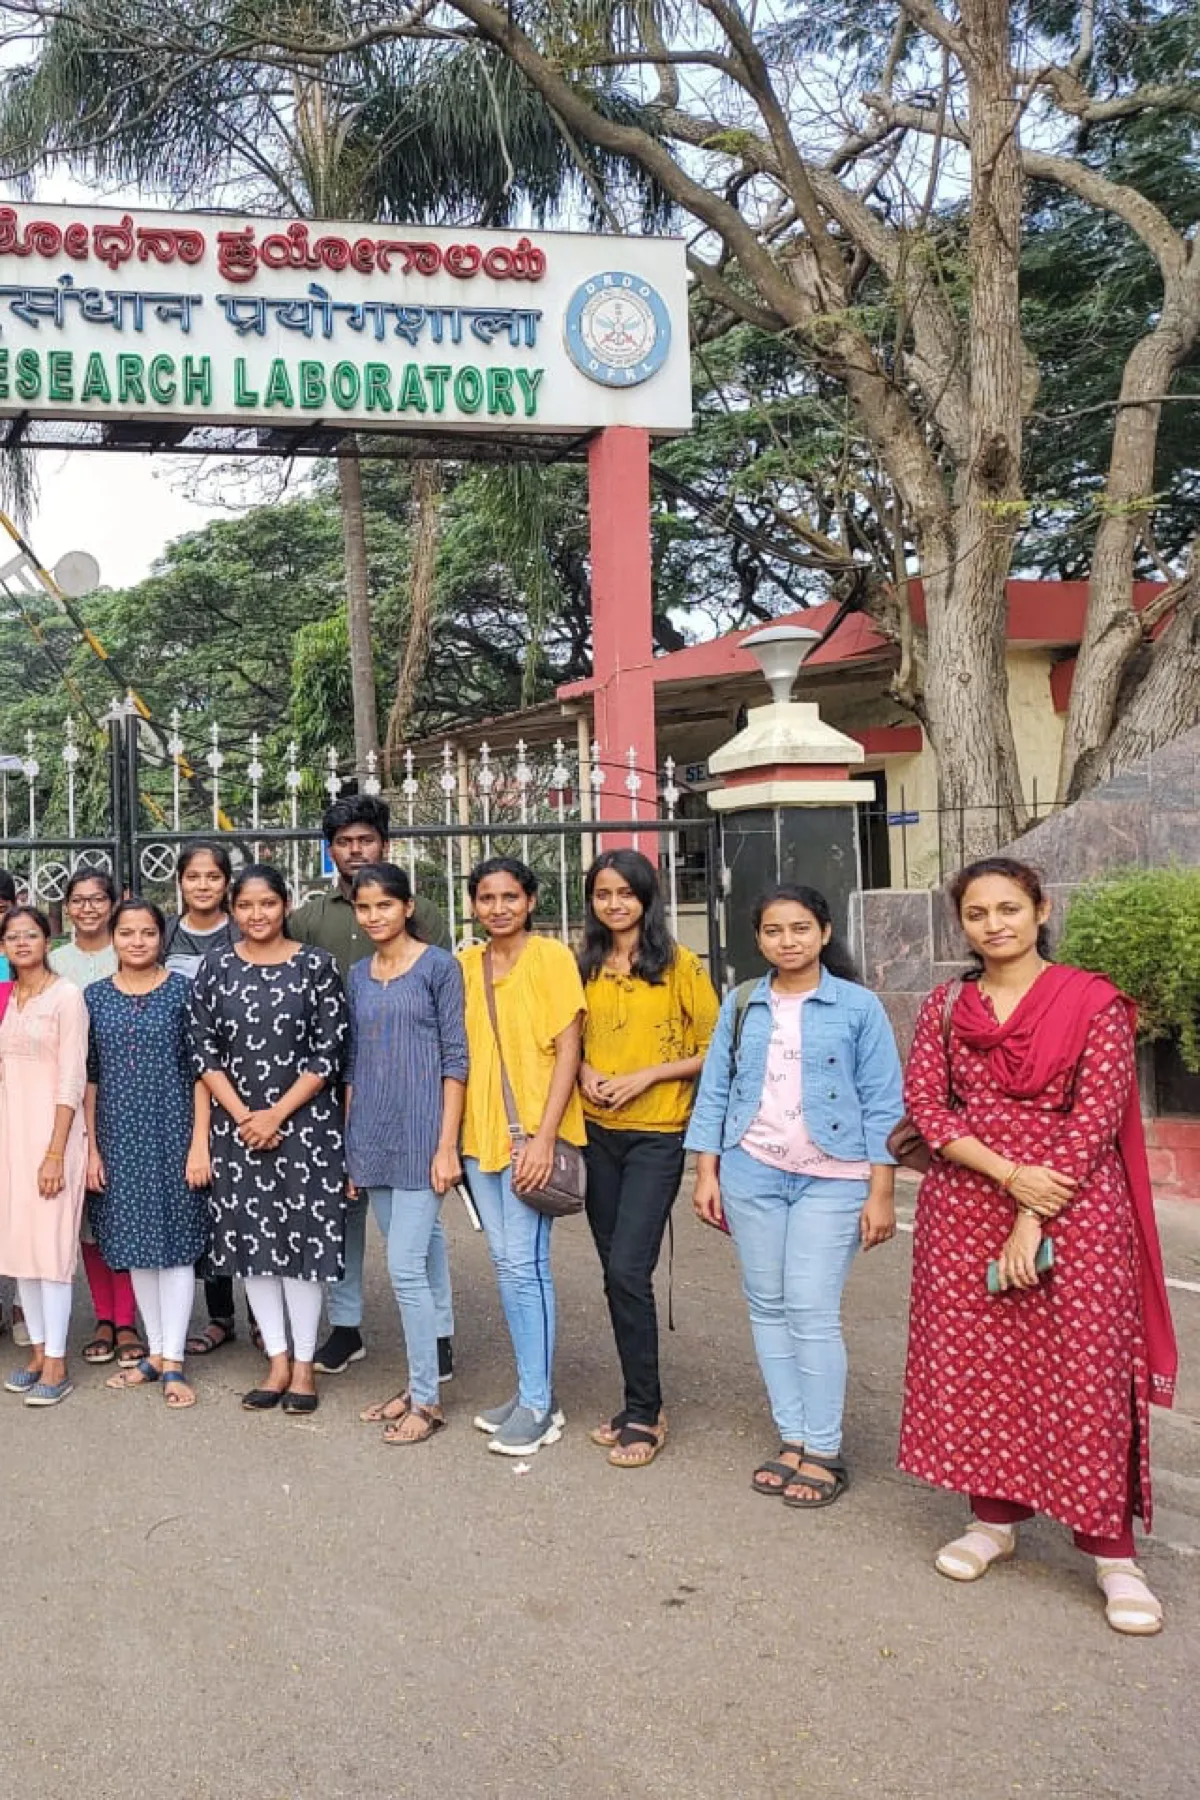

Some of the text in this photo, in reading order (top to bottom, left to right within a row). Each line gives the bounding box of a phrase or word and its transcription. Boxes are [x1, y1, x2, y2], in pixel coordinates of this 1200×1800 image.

[216, 222, 546, 283] ಪ್ರಯೋಗಾಲಯ
[215, 283, 542, 347] प्रयोगशाला
[234, 358, 543, 416] LABORATORY
